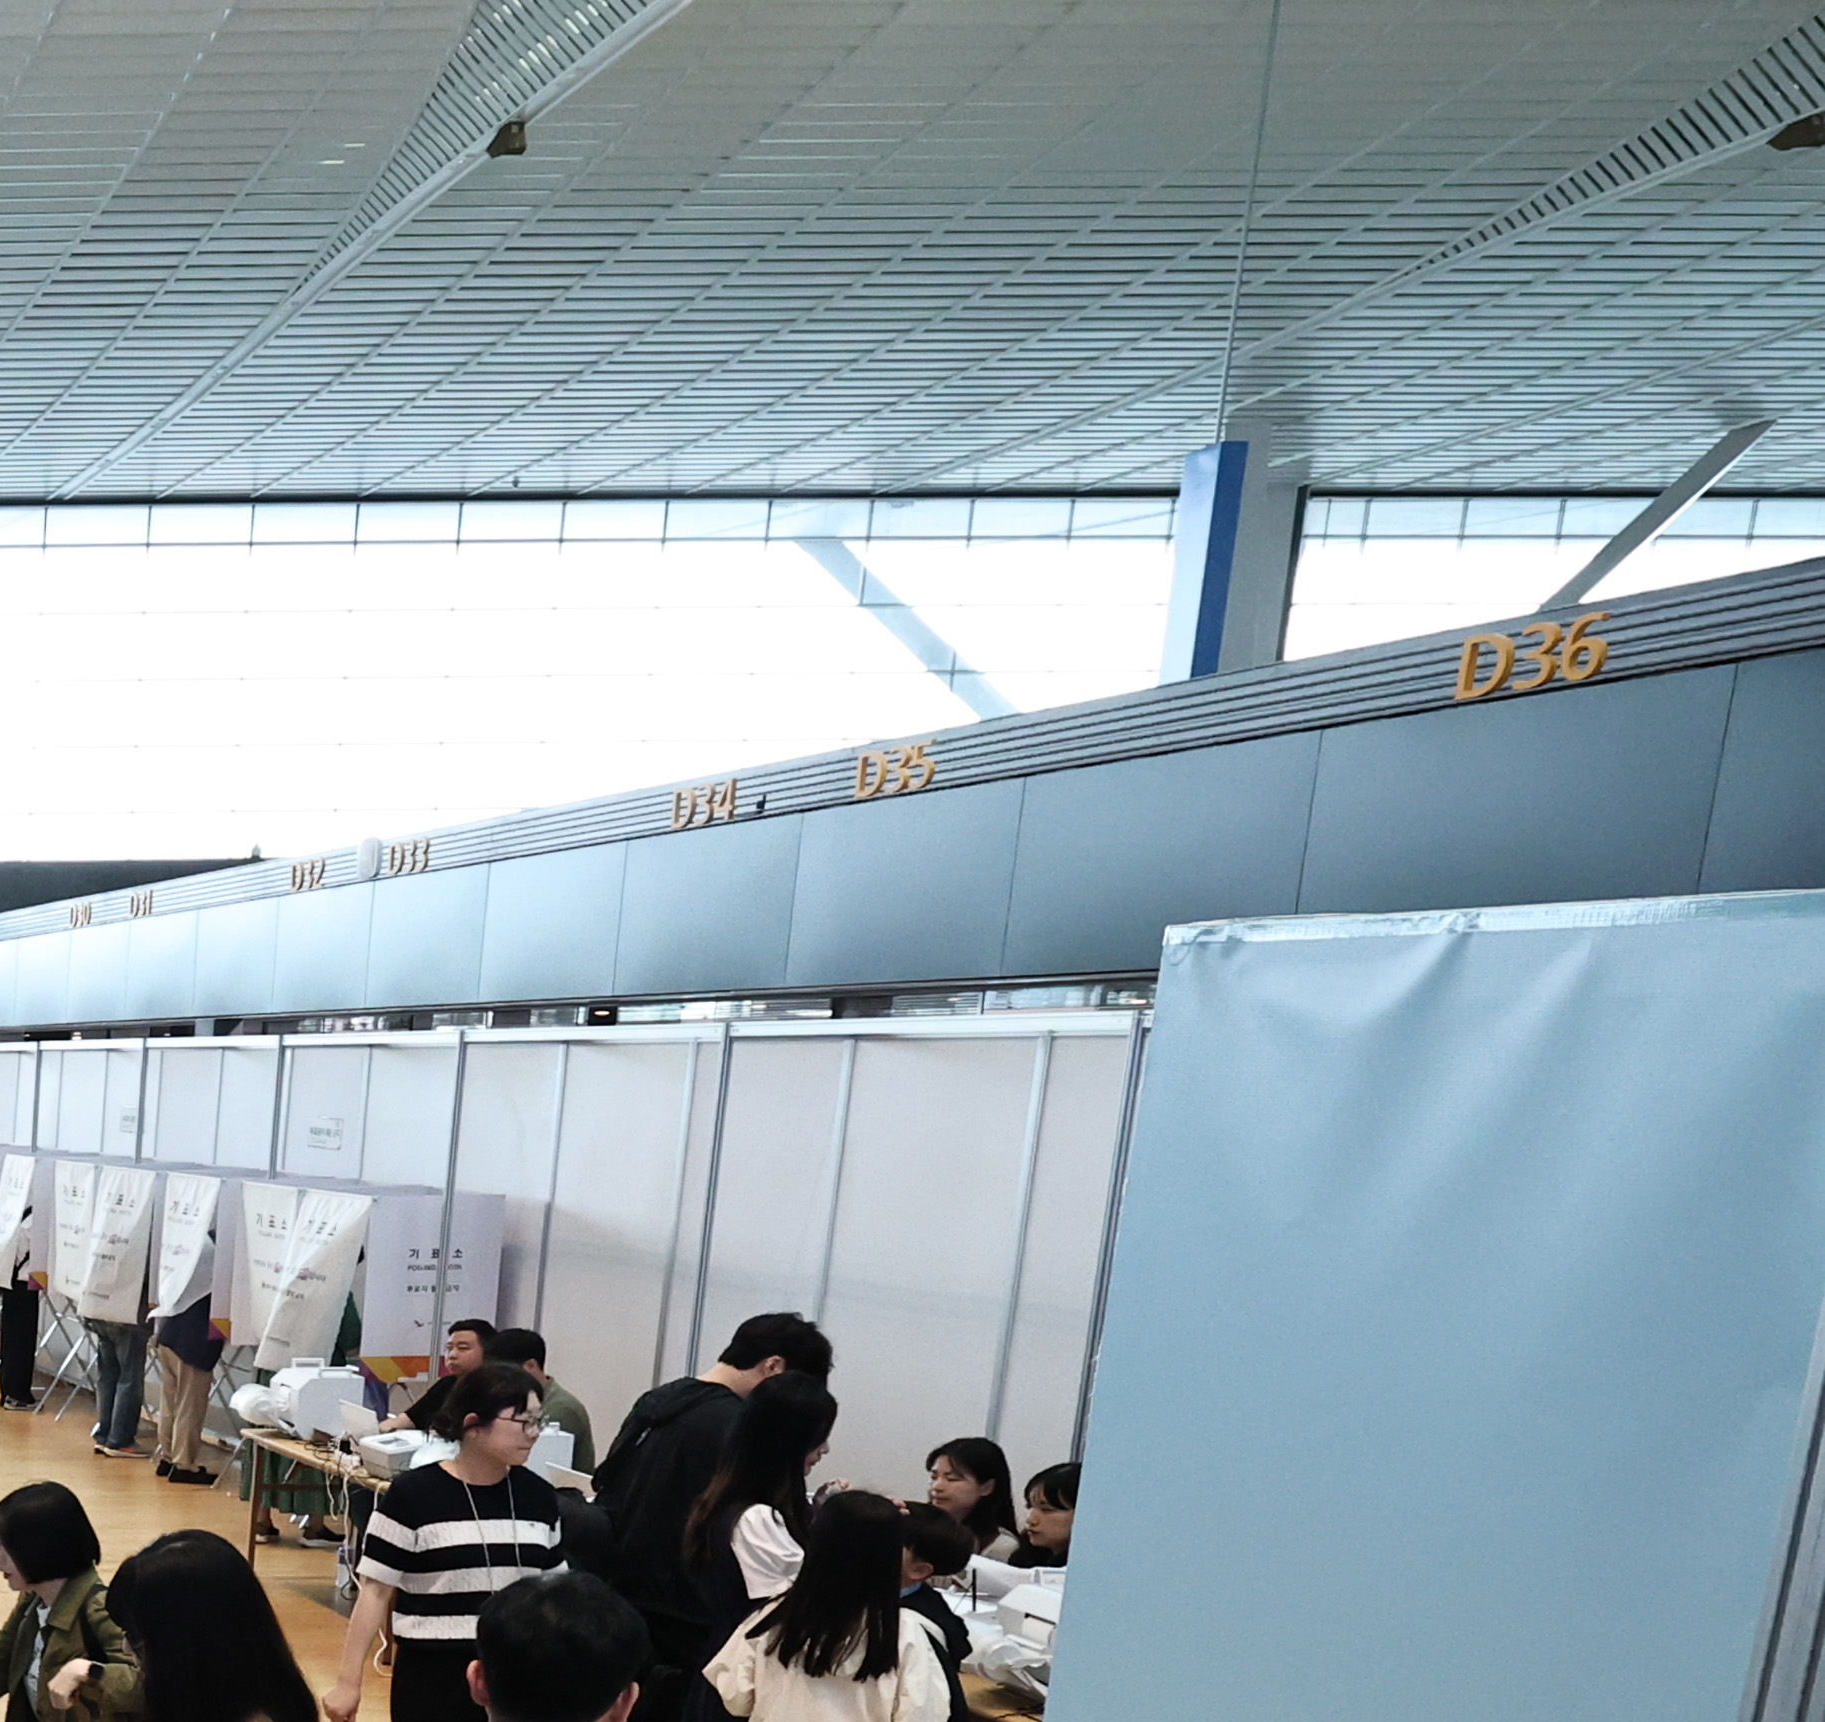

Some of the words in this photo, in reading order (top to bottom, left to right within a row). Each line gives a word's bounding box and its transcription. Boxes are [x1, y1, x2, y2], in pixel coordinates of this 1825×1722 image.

[1455, 611, 1612, 699] D36
[855, 740, 935, 799] D35
[670, 777, 737, 829] D34
[290, 856, 326, 891] D32
[389, 836, 430, 876] D33
[129, 889, 153, 919] D31
[256, 1212, 288, 1231] 기표소
